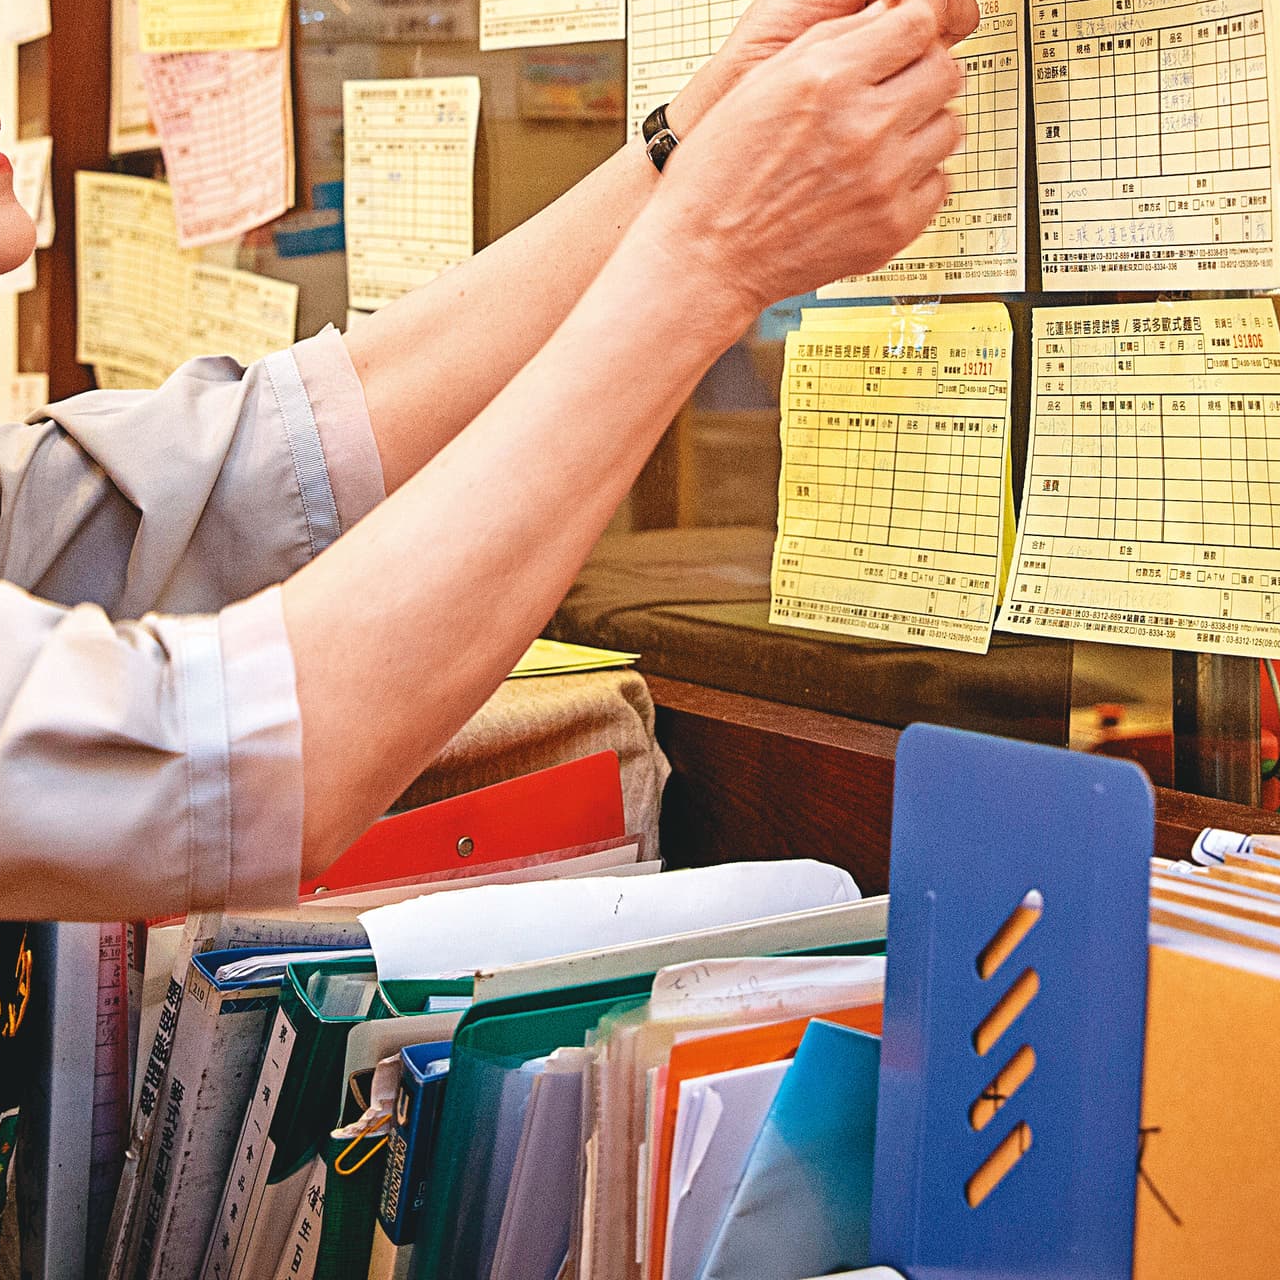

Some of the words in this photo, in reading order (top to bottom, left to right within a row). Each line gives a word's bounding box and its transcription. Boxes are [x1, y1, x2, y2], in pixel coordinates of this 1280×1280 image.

[1042, 48, 1055, 57] 品名
[1046, 319, 1119, 335] 花蓮縣餅菩提餅舖
[1133, 317, 1201, 333] 麥式多歐式麵包
[1233, 334, 1263, 348] 191806
[963, 363, 992, 375] 191717
[1047, 401, 1060, 411] 品名
[1141, 400, 1154, 411] 小計
[1172, 401, 1185, 411] 品名
